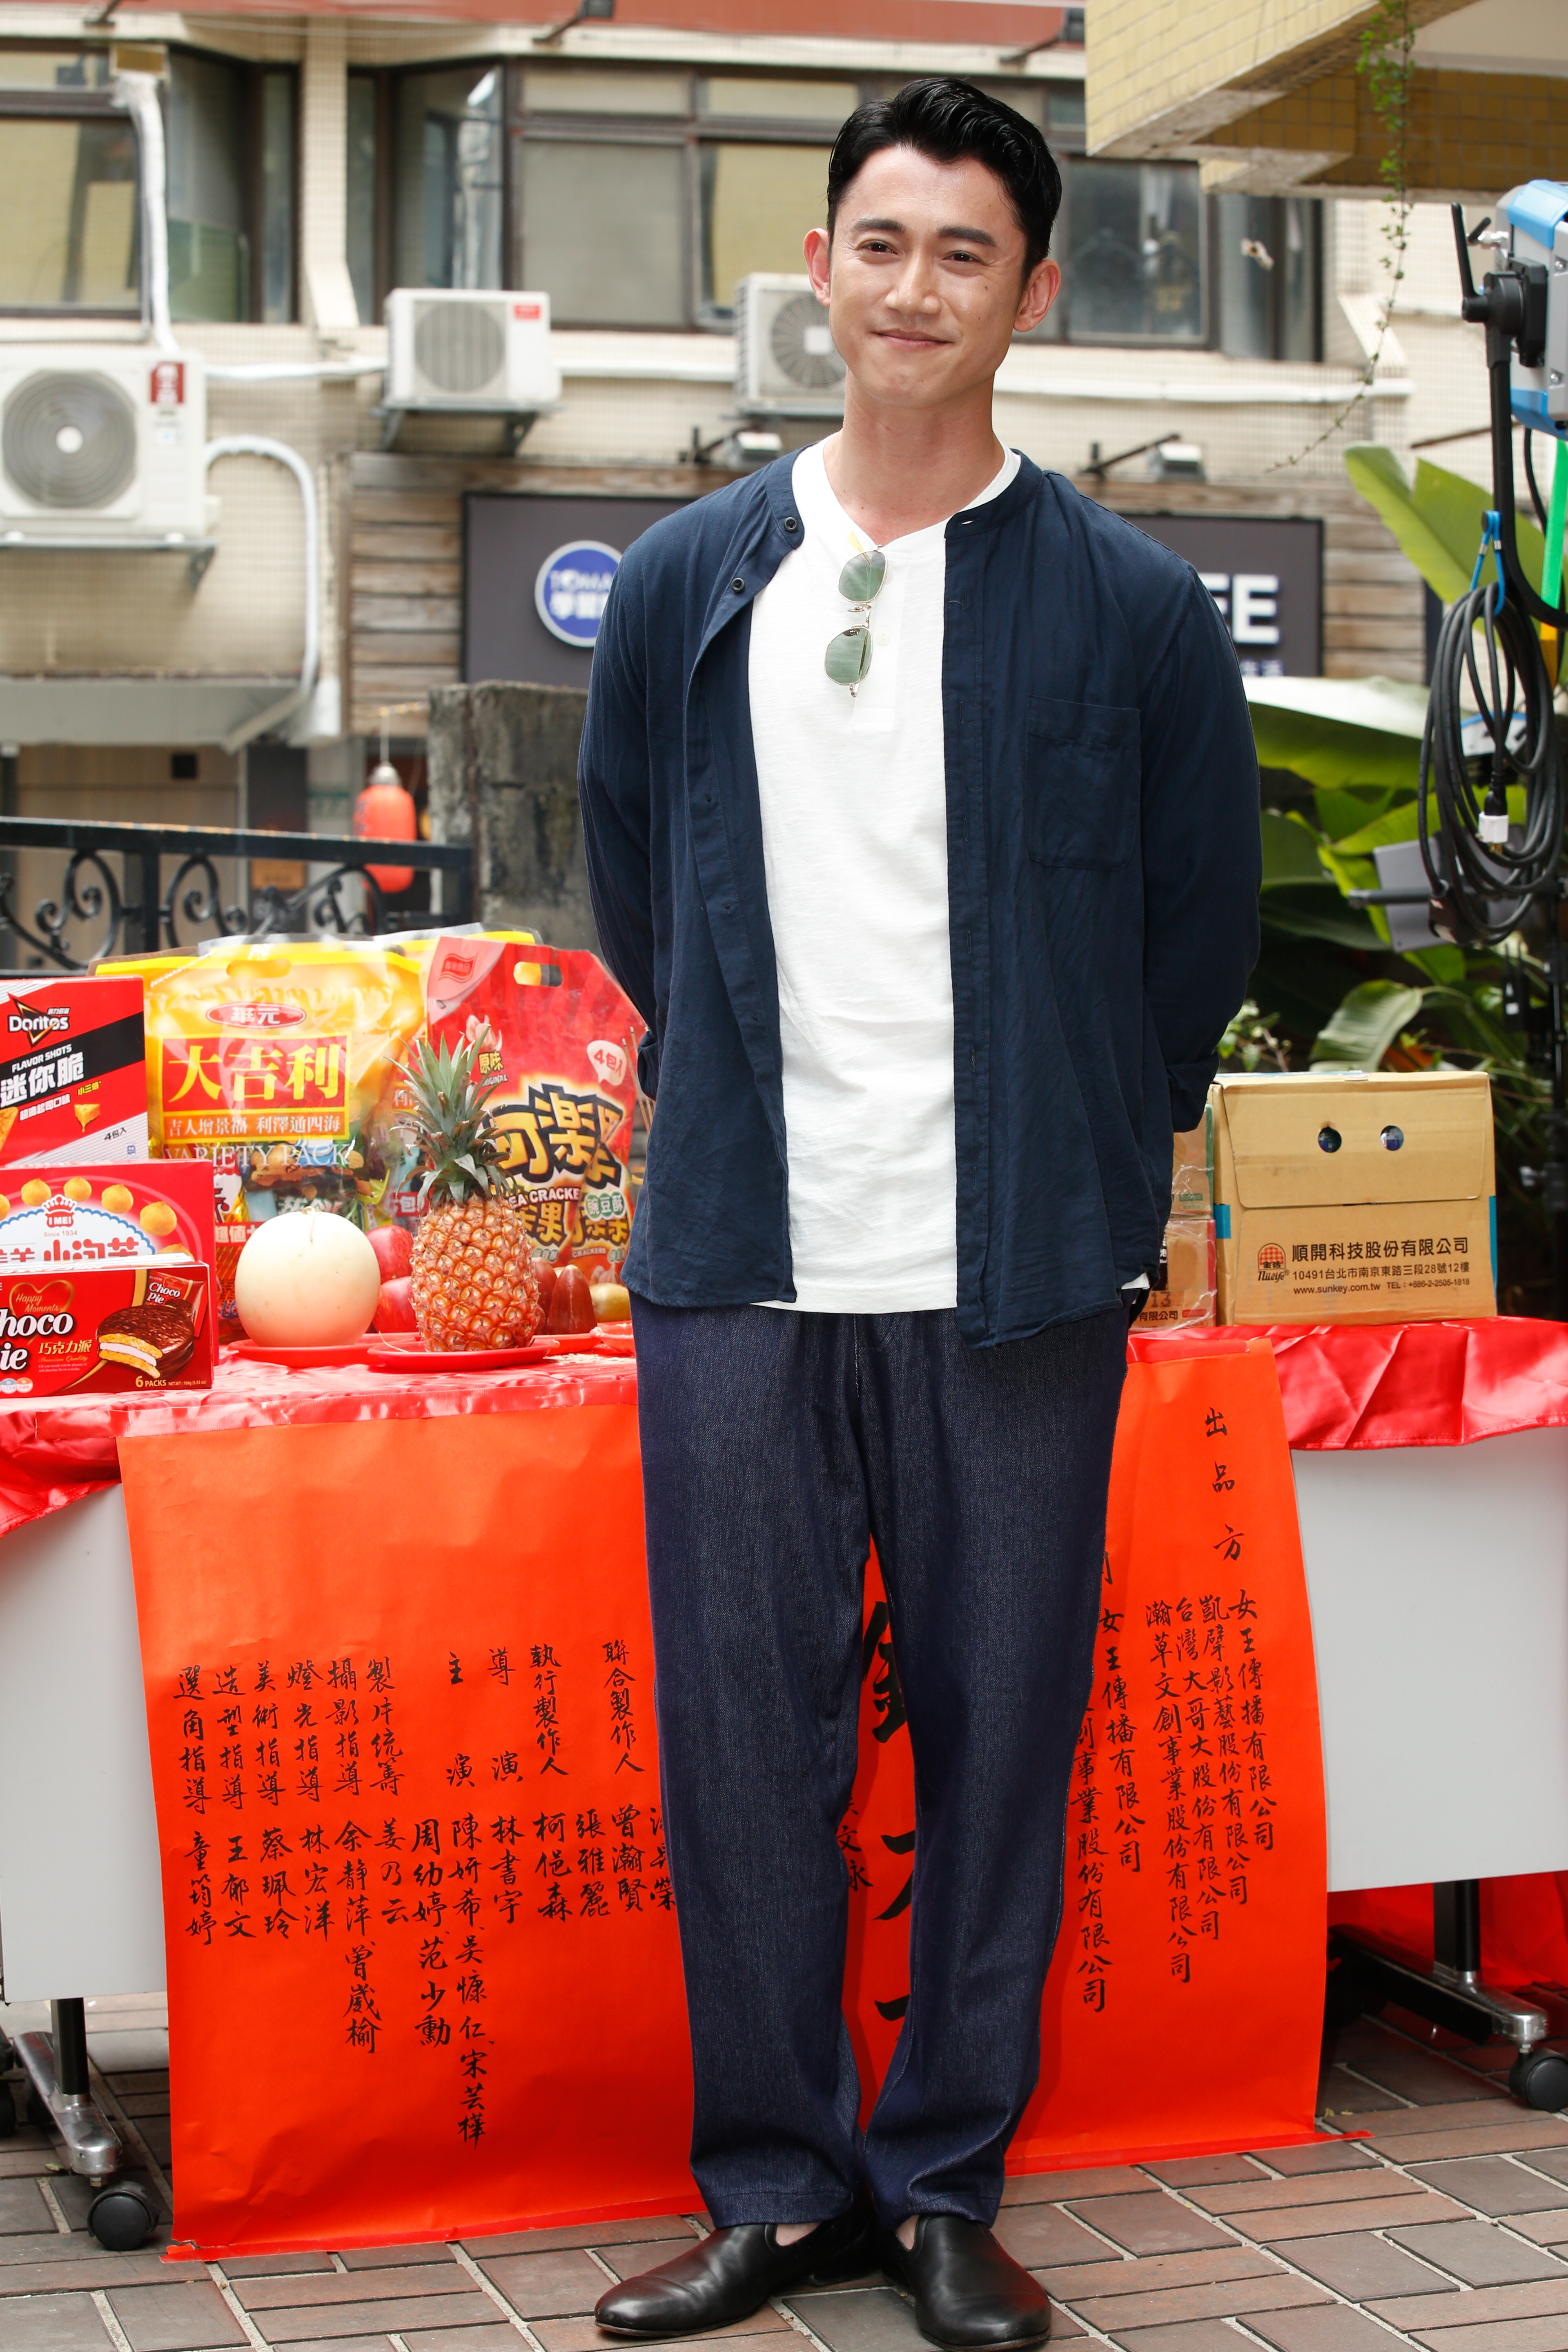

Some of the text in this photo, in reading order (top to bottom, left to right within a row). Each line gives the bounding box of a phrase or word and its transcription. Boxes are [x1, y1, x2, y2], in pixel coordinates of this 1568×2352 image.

[9, 1016, 69, 1032] Doritos
[231, 1007, 281, 1025] 華元
[12, 1044, 72, 1073] FLAVOR SHOTS
[479, 1051, 504, 1074] 原味
[594, 1049, 622, 1078] 4包入
[0, 1051, 84, 1107] 迷你脆
[169, 1043, 343, 1103] 大吉利
[482, 1074, 508, 1087] IGINAL
[104, 1127, 127, 1141] 4包入
[169, 1116, 341, 1136] 吉人增景福 利澤通四海
[164, 1144, 350, 1168] VARIETY PACK
[53, 1216, 71, 1225] MEI
[572, 1247, 606, 1258] CRACKERS
[1292, 1237, 1468, 1262] 順開科技股份有限公司
[1293, 1261, 1469, 1280] 10491台北市南京東路三段28號12樓
[16, 1294, 42, 1305] Happy
[147, 1292, 165, 1304] Pie
[149, 1282, 181, 1298] Choco
[1294, 1283, 1380, 1294] www.sunkey.com.tw
[1409, 1278, 1470, 1287] +886-2-2505-1818
[24, 1304, 59, 1313] Moments
[1138, 1310, 1178, 1321] 有限公司
[0, 1342, 28, 1370] ie
[38, 1339, 93, 1355] 巧克力派
[65, 1354, 88, 1363] Quality
[135, 1376, 144, 1388] 6
[1205, 1407, 1244, 1561] 出品方
[530, 1644, 568, 1775] 執行製作人
[602, 1639, 645, 1775] 聯合製作人
[1229, 1589, 1276, 1850] 女王傳播有限公司
[173, 1664, 212, 1814] 選角指導
[325, 1658, 362, 1796] 攝影指導
[1099, 1608, 1145, 1873] 女王傳播有限公司
[1176, 1597, 1226, 1940] 台灣大哥大股份有限公司
[212, 1665, 256, 1938] 造型指導 王郁文
[252, 1660, 299, 1939] 美術指導 蔡珮玲
[287, 1659, 334, 1942] 燈光指導 林宏洋
[1146, 1600, 1197, 1983] 瀚草文創事業股份有限公司
[836, 1796, 873, 1891] 文永
[374, 1817, 409, 1924] 姜乃云
[490, 1815, 525, 1923] 林書宇
[612, 1804, 648, 1912] 曾瀚賢
[1070, 1708, 1113, 2013] 創事業股份有限公司
